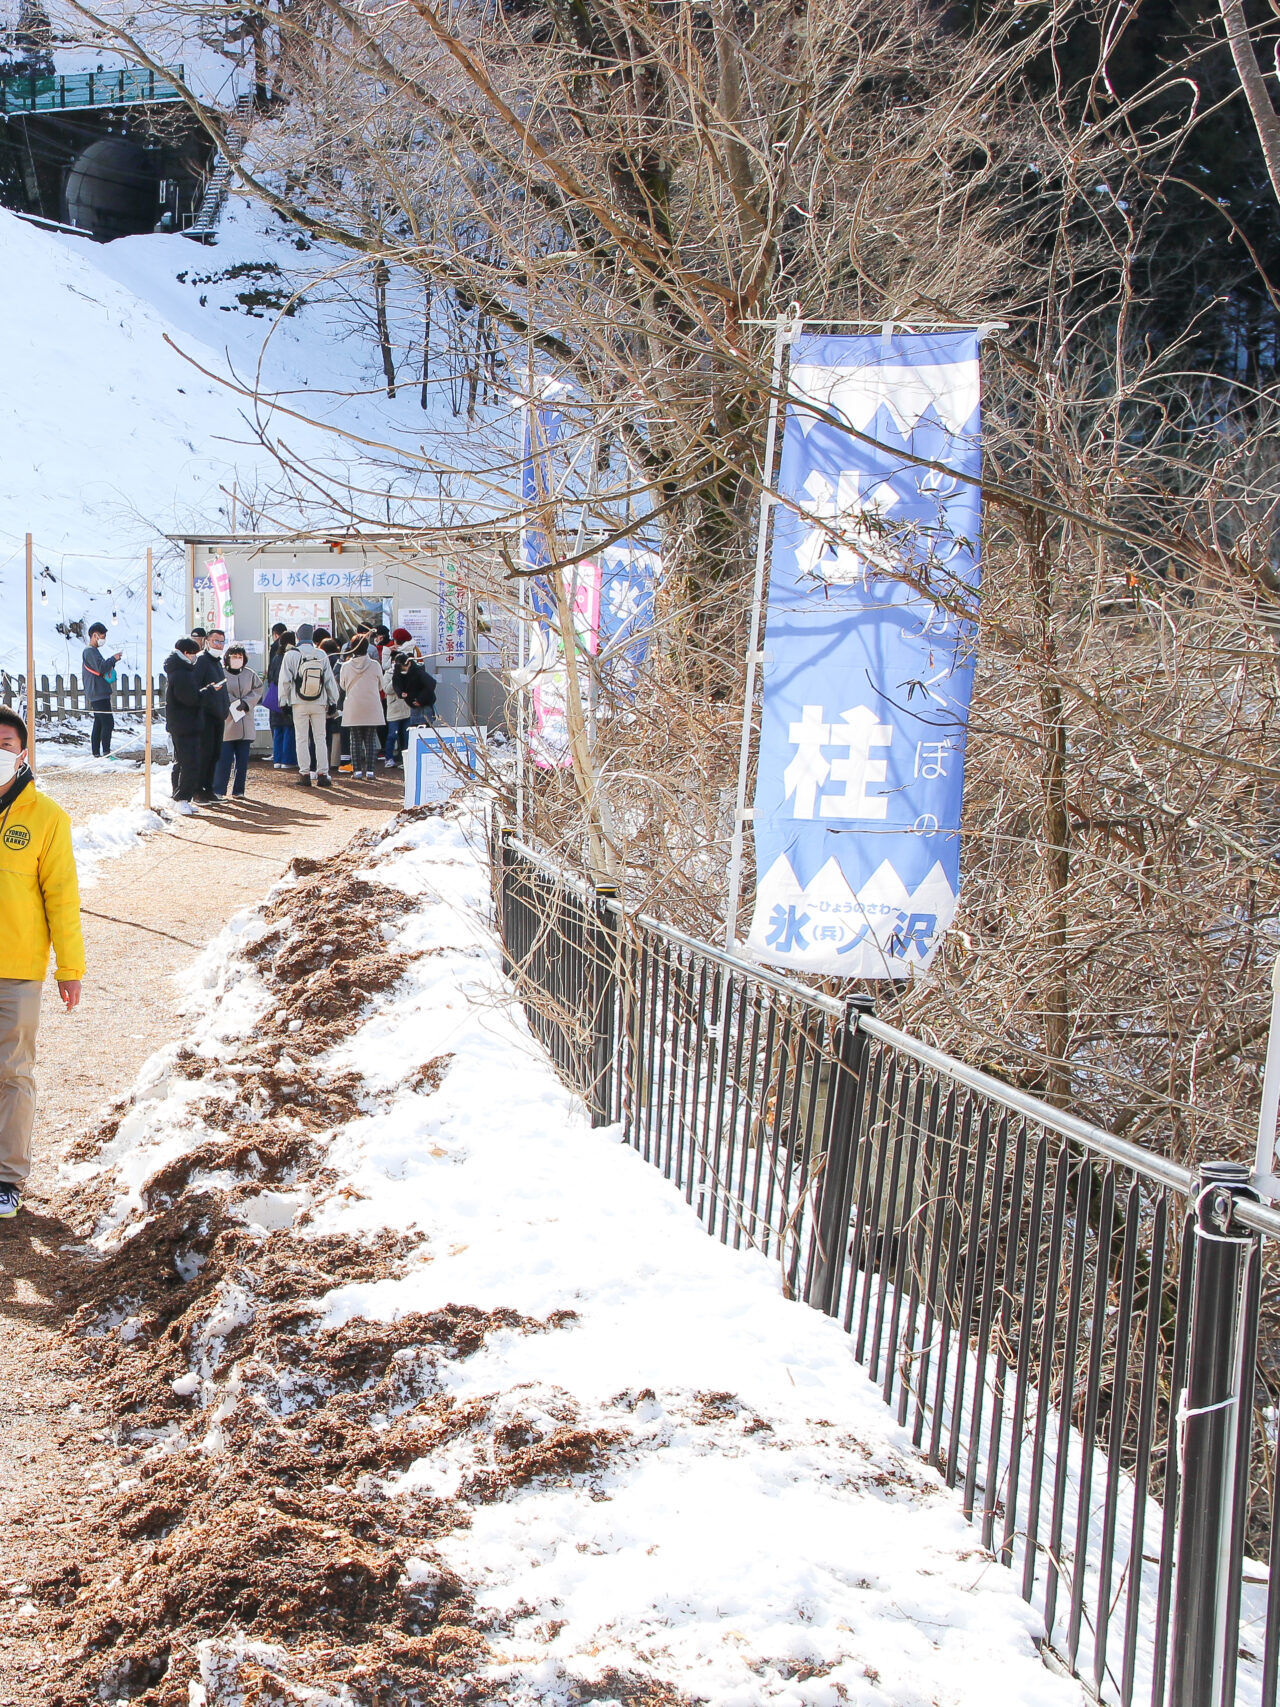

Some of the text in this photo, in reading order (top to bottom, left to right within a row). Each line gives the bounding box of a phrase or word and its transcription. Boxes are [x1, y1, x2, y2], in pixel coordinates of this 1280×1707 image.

[257, 571, 373, 588] あしがくぼの氷柱
